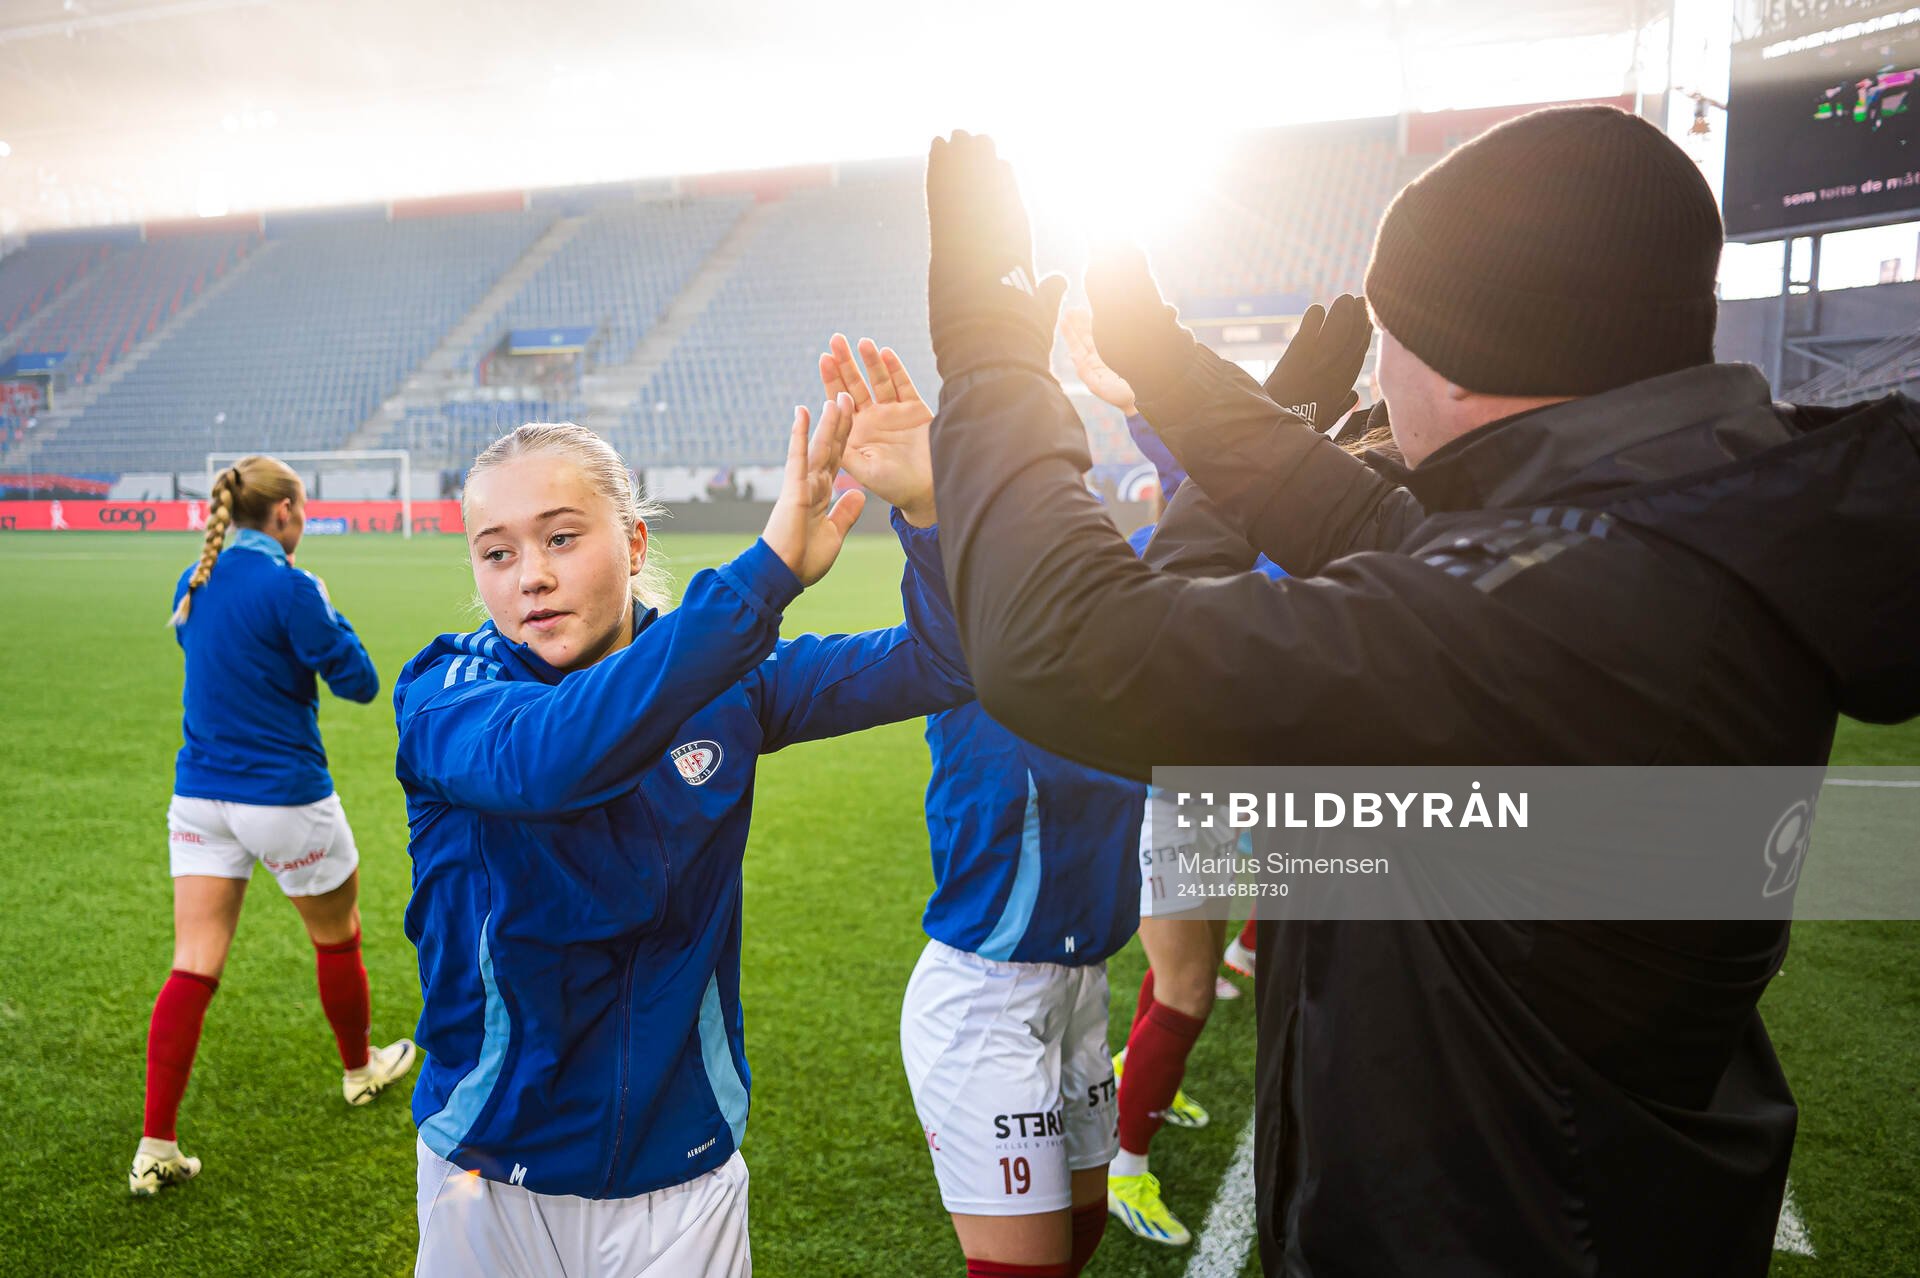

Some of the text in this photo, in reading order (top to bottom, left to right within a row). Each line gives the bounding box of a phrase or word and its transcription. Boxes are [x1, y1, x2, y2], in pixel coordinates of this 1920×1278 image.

[1861, 180, 1883, 194] de
[99, 508, 156, 530] coop
[509, 1162, 528, 1187] M
[999, 1156, 1032, 1195] 19
